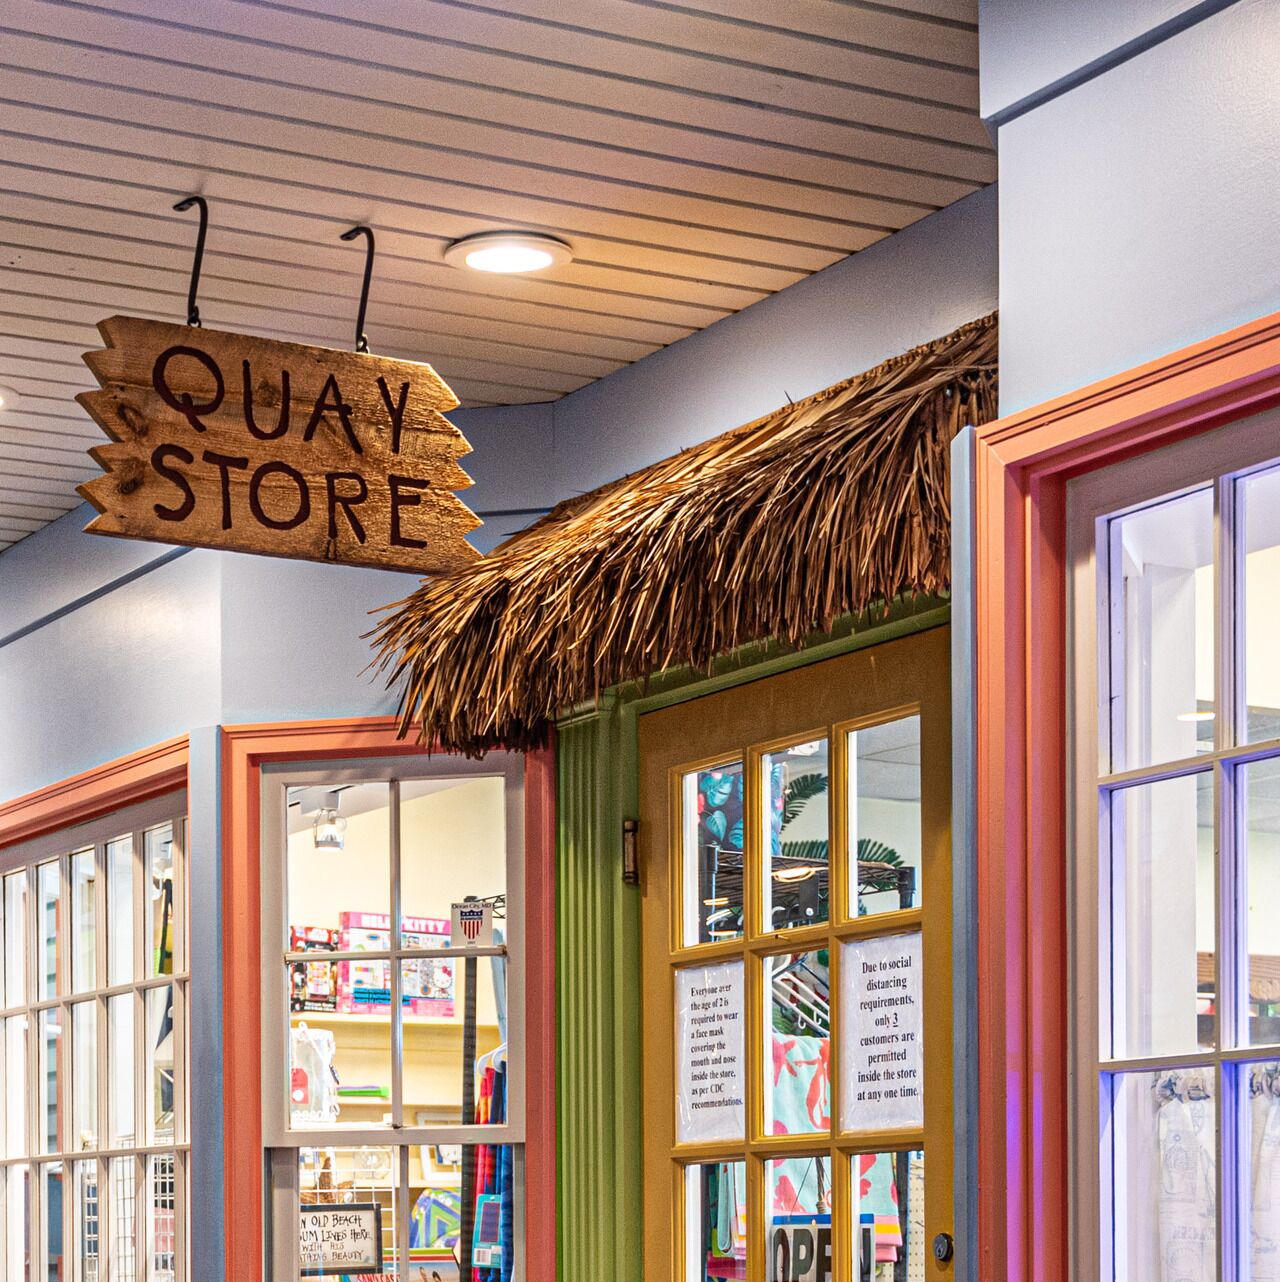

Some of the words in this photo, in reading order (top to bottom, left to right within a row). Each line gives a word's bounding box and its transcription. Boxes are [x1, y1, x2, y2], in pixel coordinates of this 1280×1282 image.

[152, 345, 410, 454] QUAY
[151, 444, 430, 548] STORE
[403, 918, 446, 932] KITTY
[862, 961, 877, 973] Due
[879, 961, 887, 971] to
[889, 956, 911, 969] social
[867, 977, 907, 991] distancing
[691, 1002, 700, 1011] the
[701, 1002, 711, 1010] age
[712, 999, 719, 1008] of
[719, 999, 723, 1007] 2
[724, 998, 728, 1006] is
[691, 1014, 715, 1026] required
[717, 1013, 722, 1021] to
[724, 1012, 738, 1020] wear
[875, 1015, 891, 1029] only
[696, 1029, 708, 1038] face
[709, 1027, 724, 1036] mask
[860, 1033, 898, 1047] customers
[902, 1032, 914, 1042] are
[691, 1044, 715, 1053] covering
[717, 1041, 725, 1050] the
[691, 1058, 710, 1067] mouth
[711, 1056, 722, 1065] and
[868, 1049, 906, 1067] permitted
[691, 1071, 708, 1081] inside
[710, 1070, 719, 1079] the
[858, 1071, 881, 1083] inside
[883, 1069, 894, 1080] the
[897, 1068, 916, 1078] store
[699, 1087, 708, 1097] per
[710, 1084, 724, 1093] CDC
[857, 1091, 865, 1101] at
[868, 1090, 882, 1103] any
[884, 1088, 897, 1099] one
[332, 1214, 362, 1227] BEACH
[300, 1231, 318, 1242] UM
[322, 1229, 347, 1242] LIVES
[302, 1243, 322, 1253] WITH
[331, 1242, 344, 1251] HIS
[332, 1251, 363, 1262] BEAUTY
